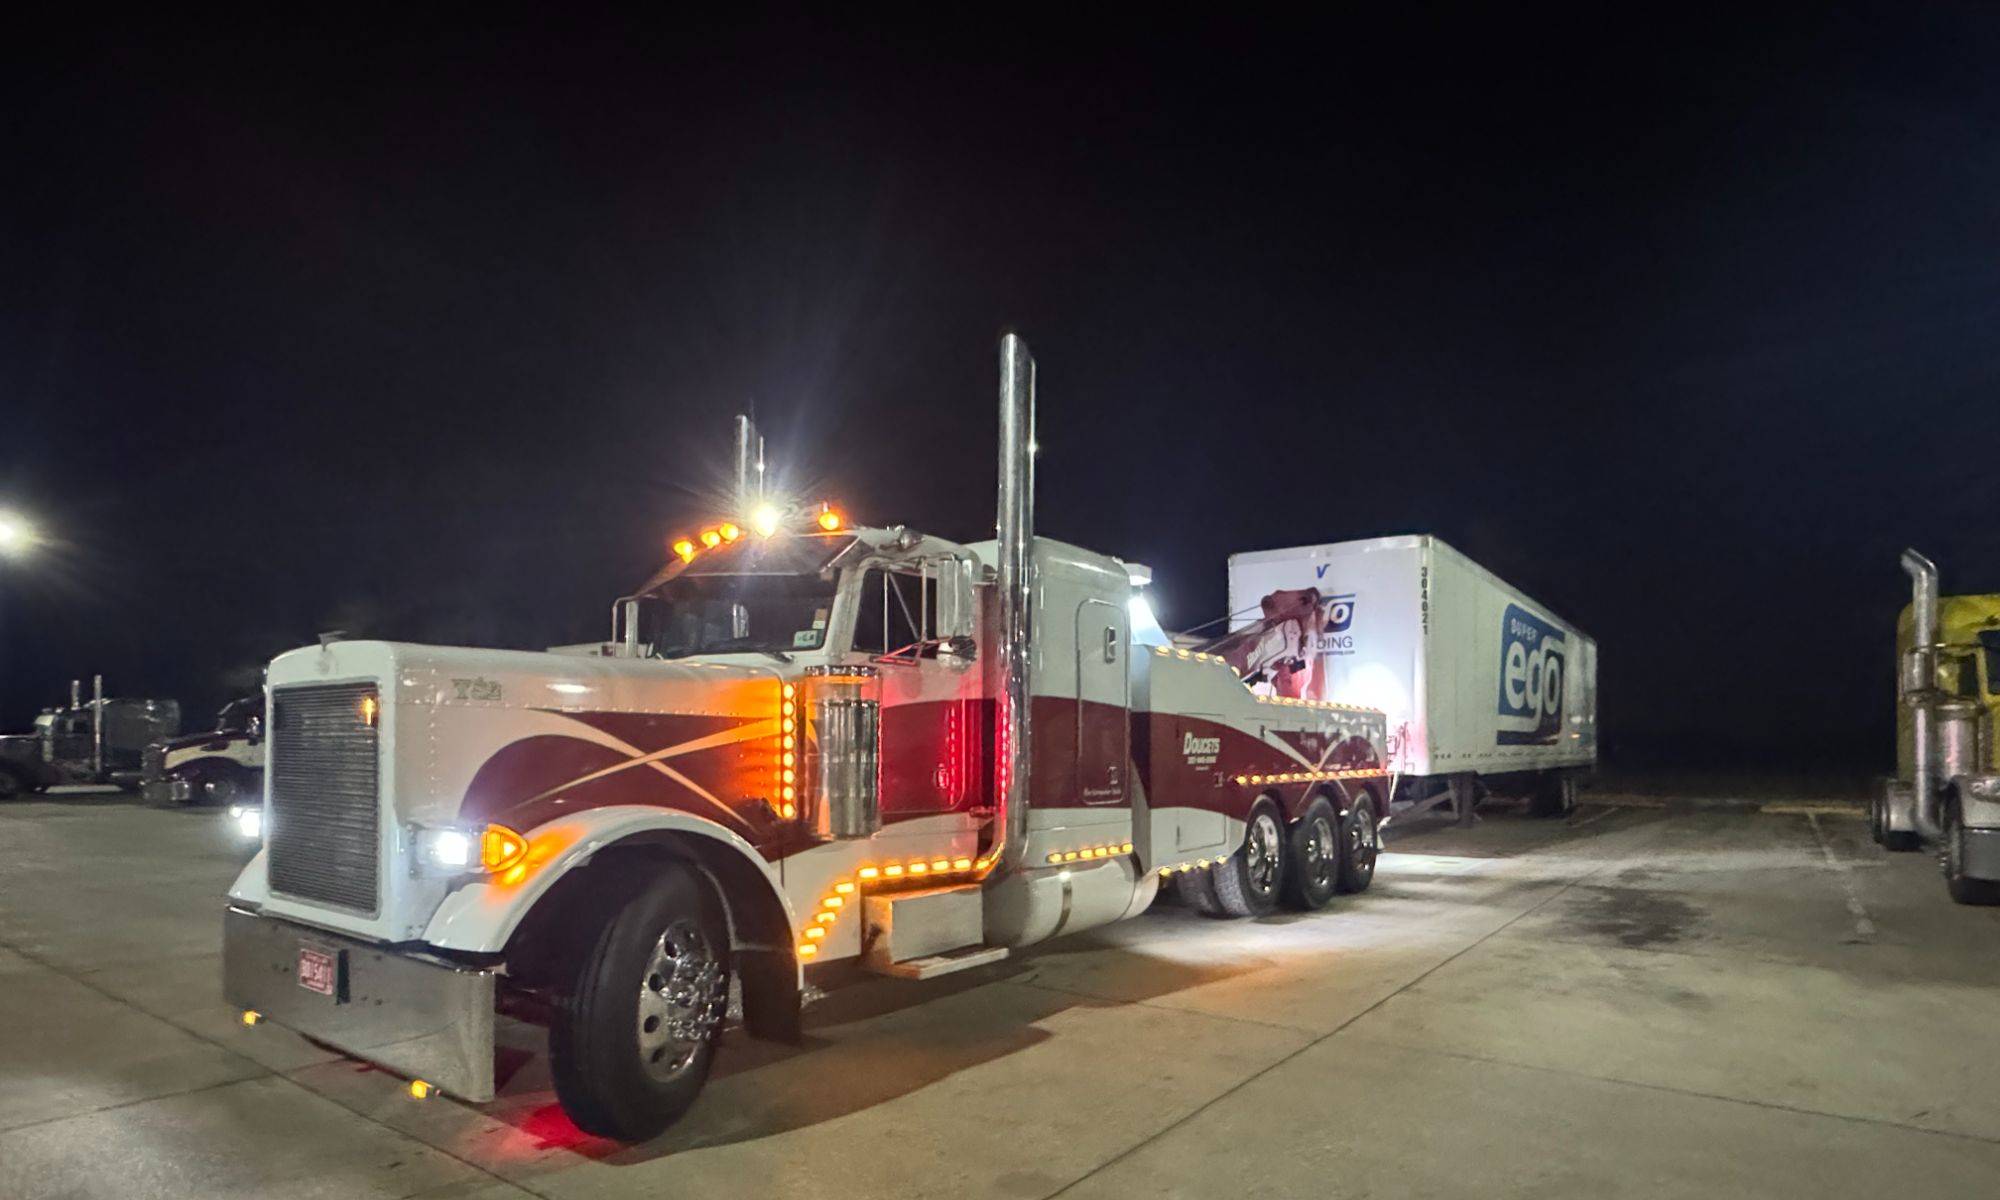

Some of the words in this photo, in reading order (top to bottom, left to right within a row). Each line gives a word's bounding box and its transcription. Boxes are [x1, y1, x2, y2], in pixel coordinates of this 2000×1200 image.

[1421, 566, 1429, 635] 304021
[1316, 636, 1353, 650] DING
[1510, 617, 1538, 643] SUPER
[1504, 637, 1561, 732] ego
